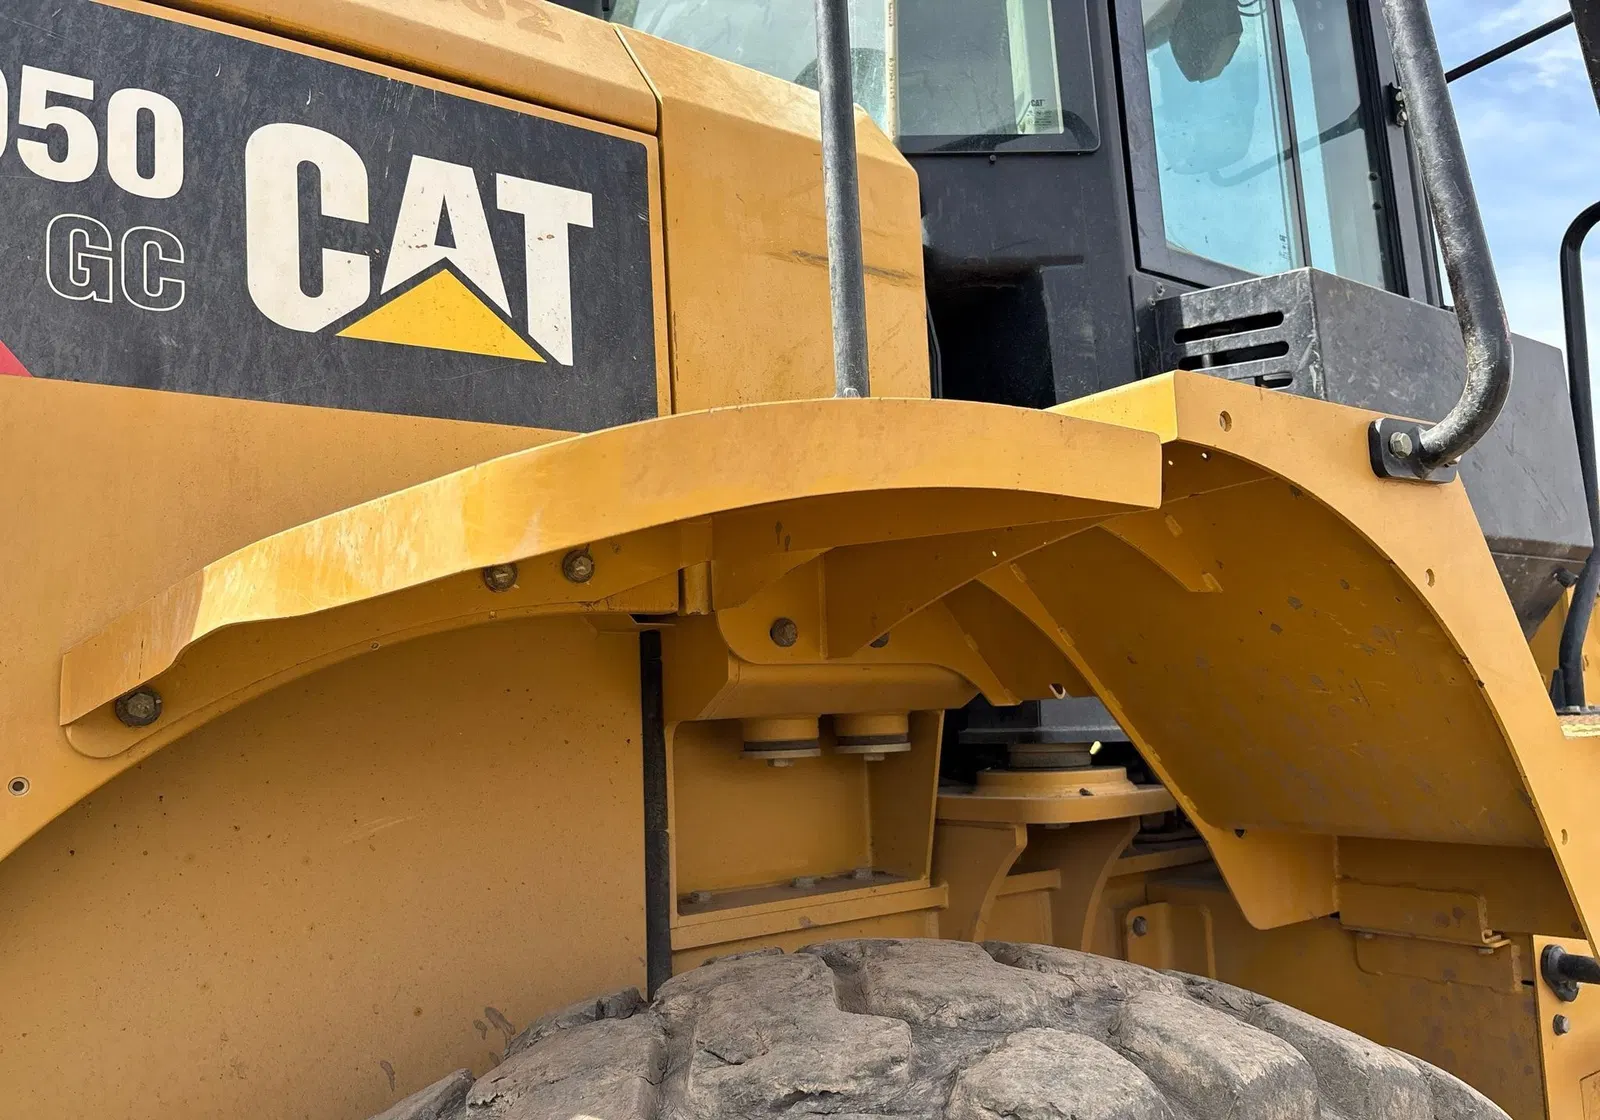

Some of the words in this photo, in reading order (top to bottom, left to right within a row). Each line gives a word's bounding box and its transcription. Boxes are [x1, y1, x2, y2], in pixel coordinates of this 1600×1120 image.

[0, 65, 184, 199] 50
[1030, 99, 1045, 107] CAT
[46, 214, 185, 311] GC
[245, 122, 593, 367] CAT
